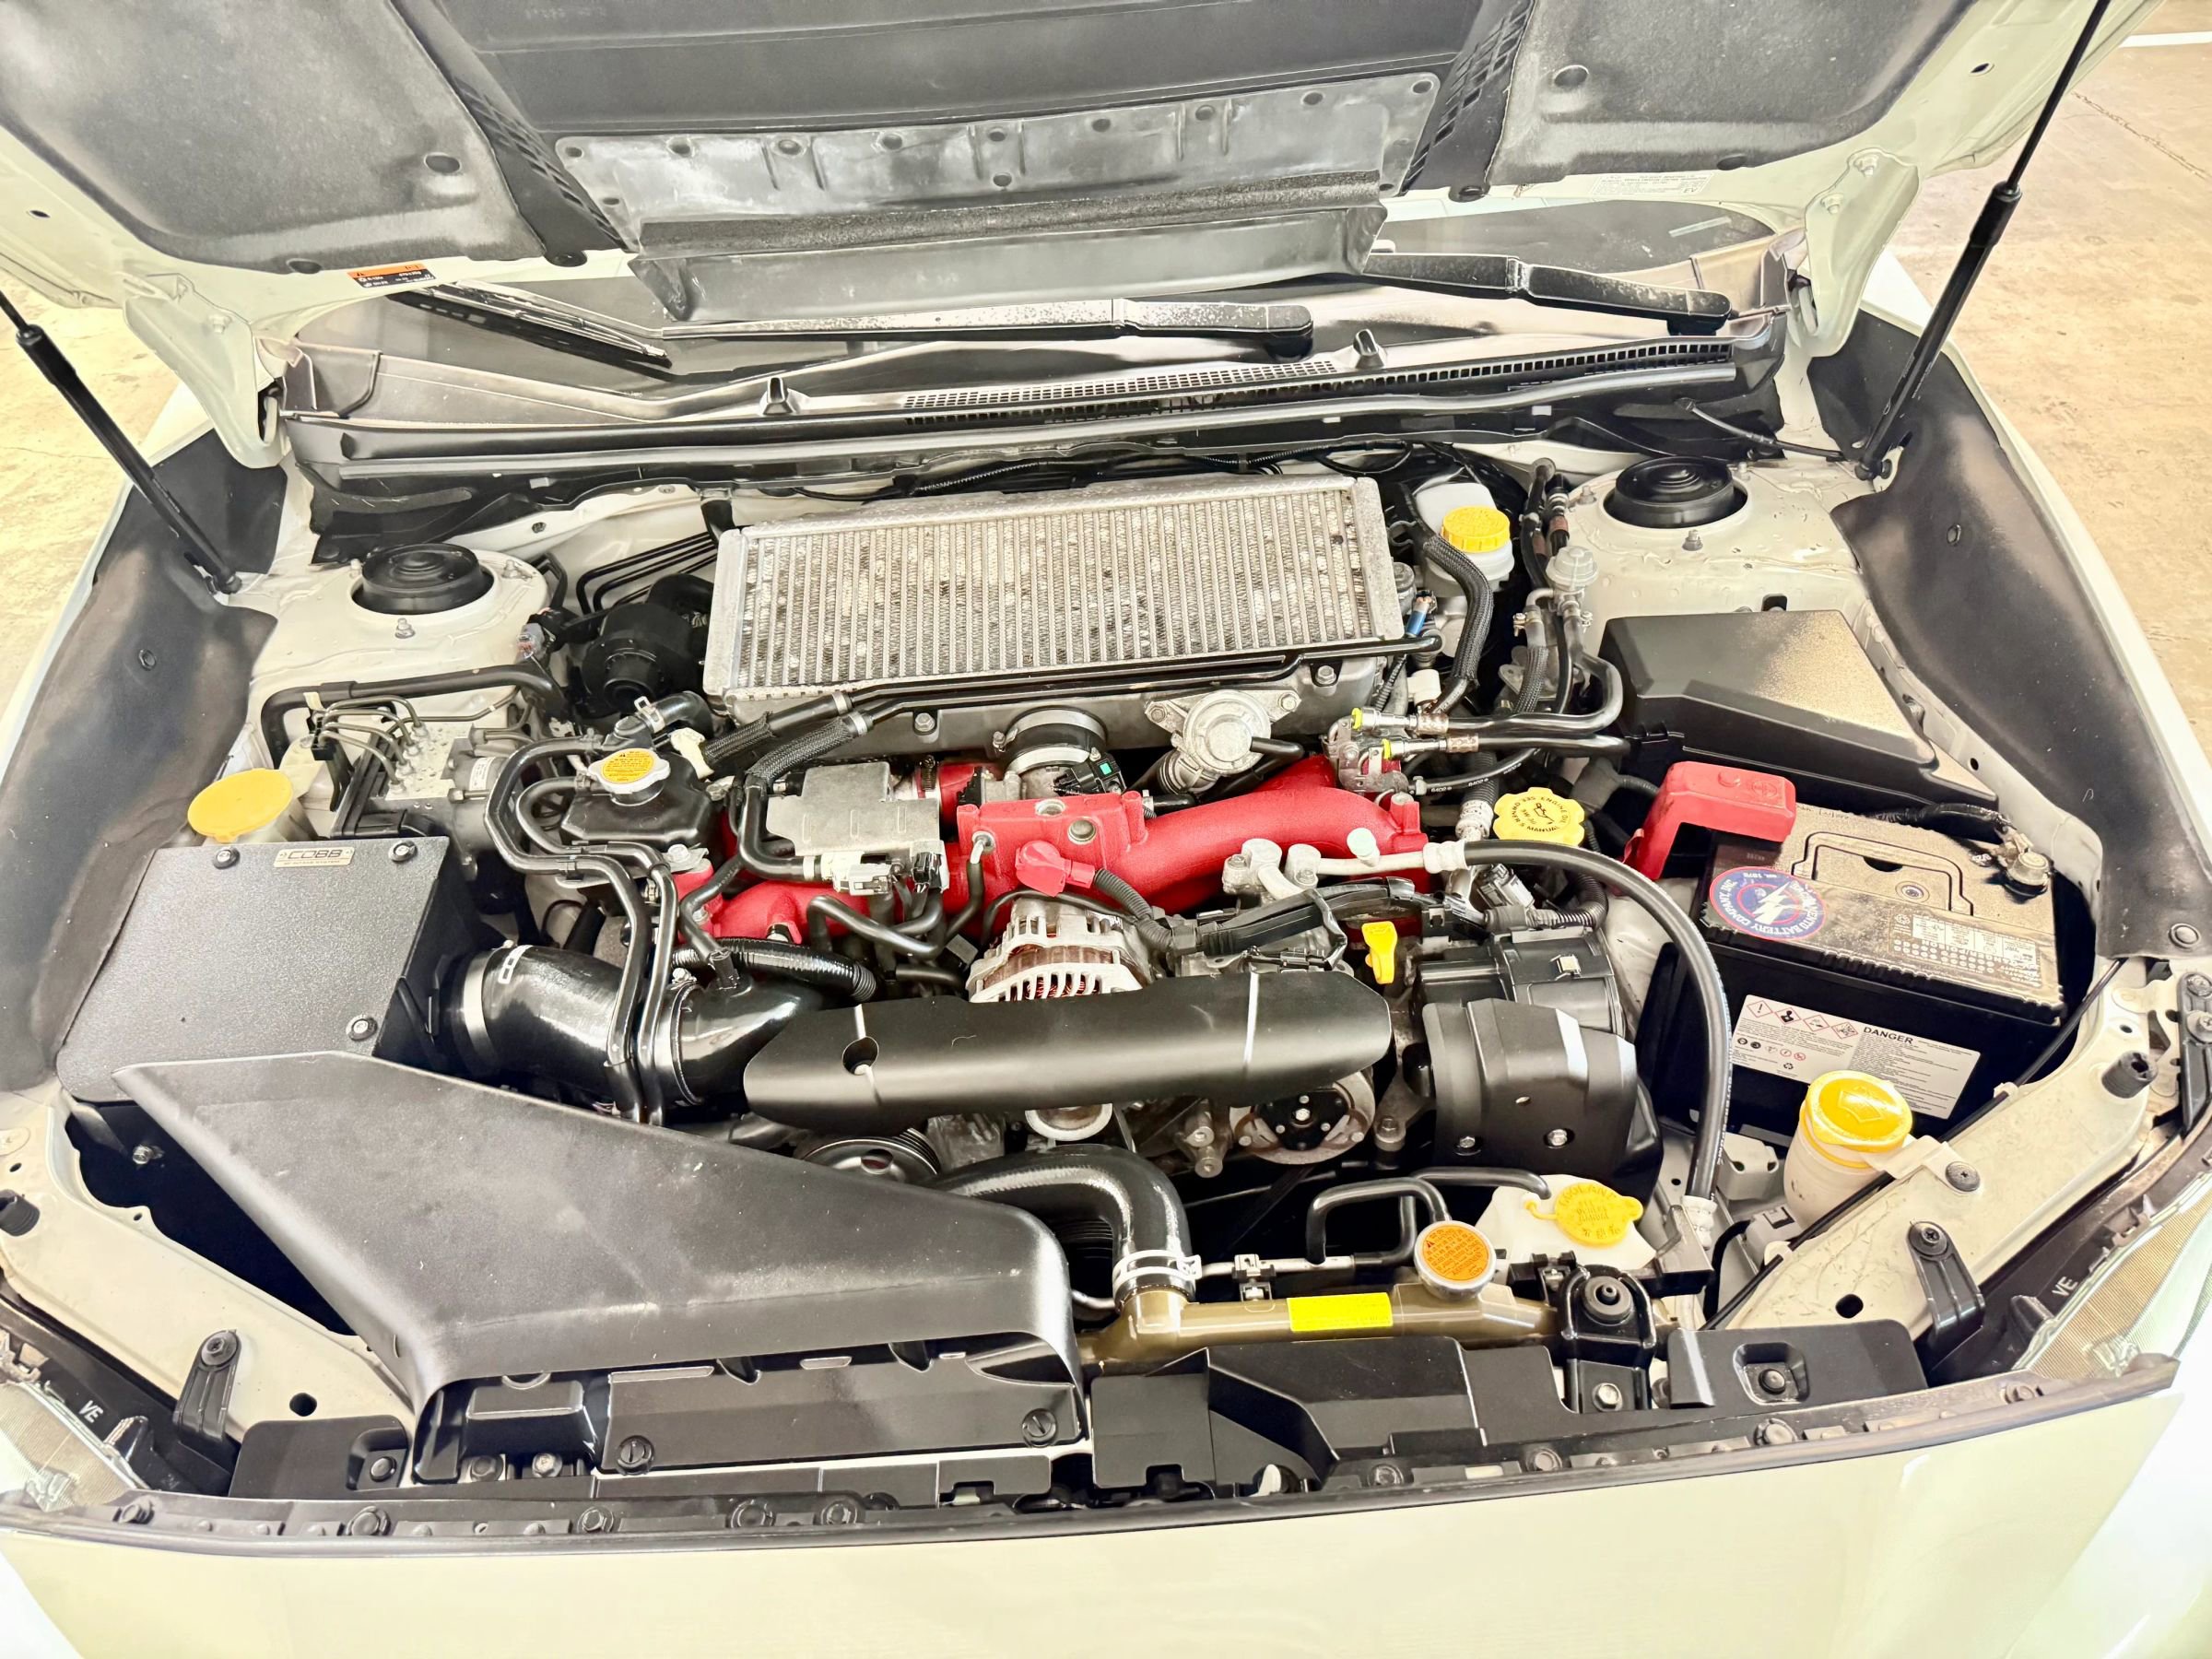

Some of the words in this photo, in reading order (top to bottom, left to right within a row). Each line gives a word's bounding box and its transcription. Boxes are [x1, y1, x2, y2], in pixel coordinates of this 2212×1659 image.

[1541, 796, 1568, 813] ENGINE
[288, 849, 343, 859] COBB
[1751, 923, 1804, 935] BATTERY
[1863, 1026, 1914, 1044] DANGER
[2052, 1277, 2078, 1296] VE
[78, 1400, 103, 1423] VE
